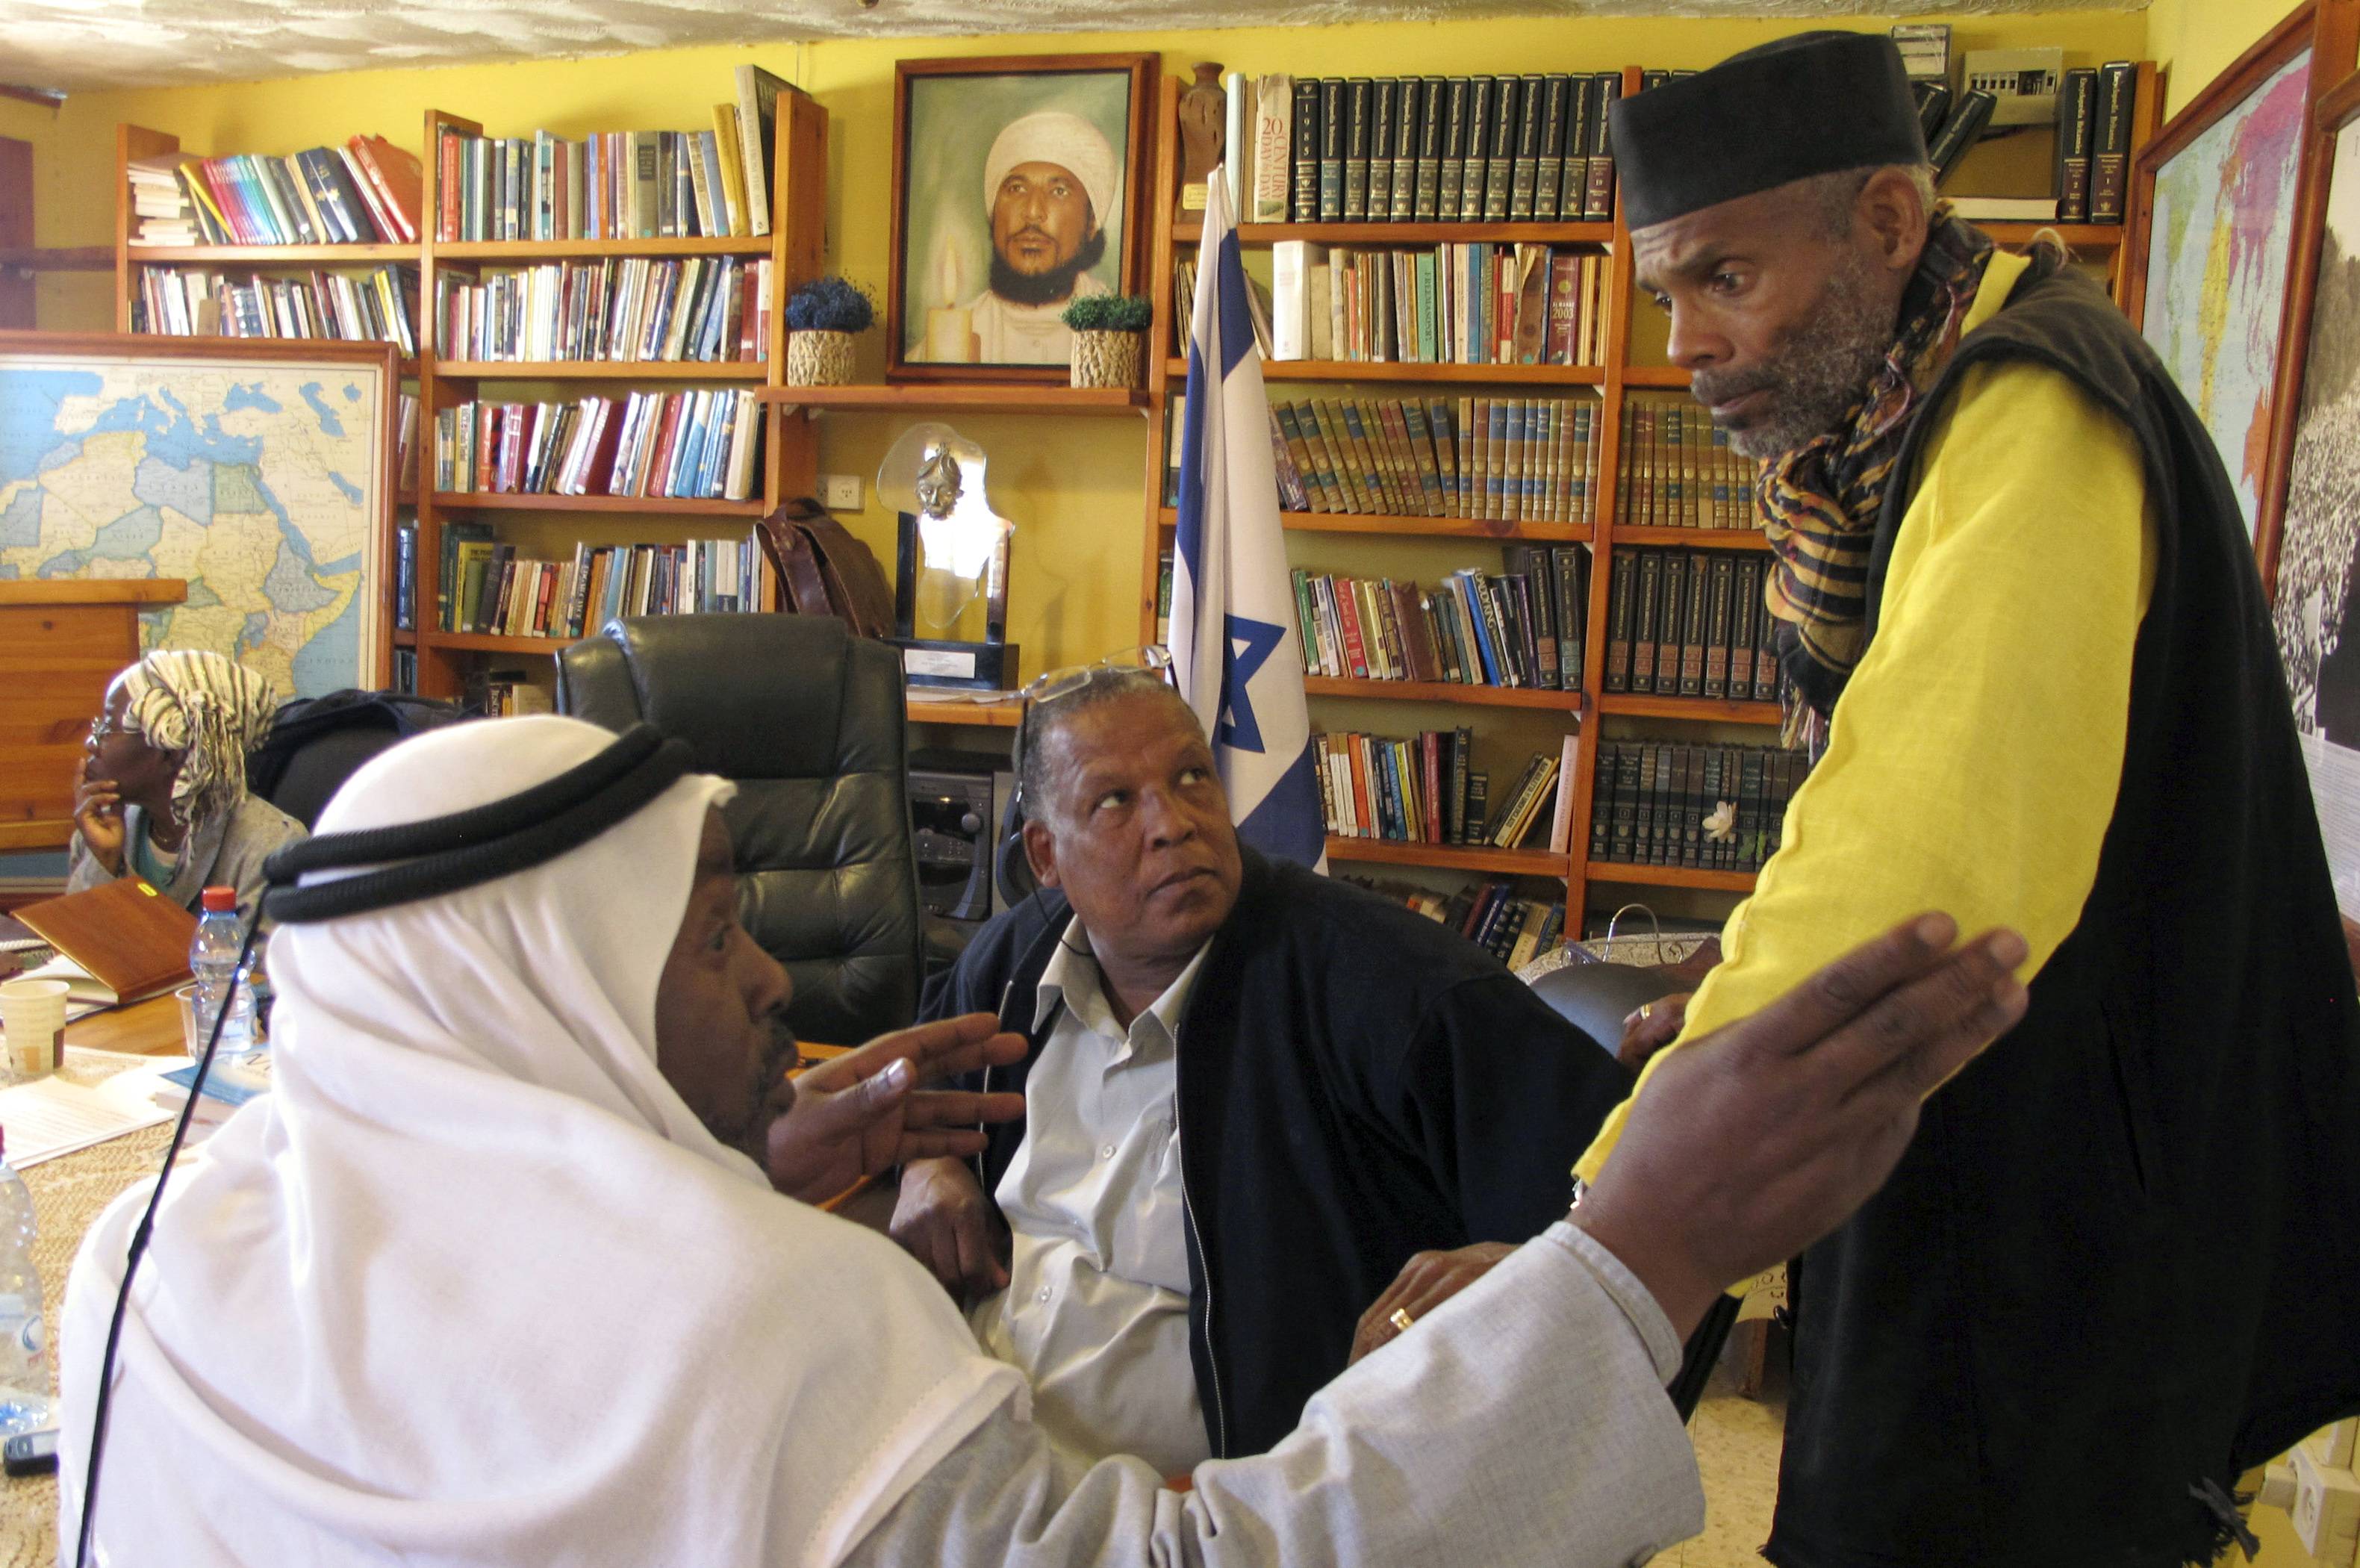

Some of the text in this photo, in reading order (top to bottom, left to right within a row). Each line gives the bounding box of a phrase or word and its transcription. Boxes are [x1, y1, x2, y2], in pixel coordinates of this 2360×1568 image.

[1271, 136, 1288, 199] CENTURY
[1552, 308, 1574, 320] 2003
[1475, 573, 1497, 629] DADDY KING
